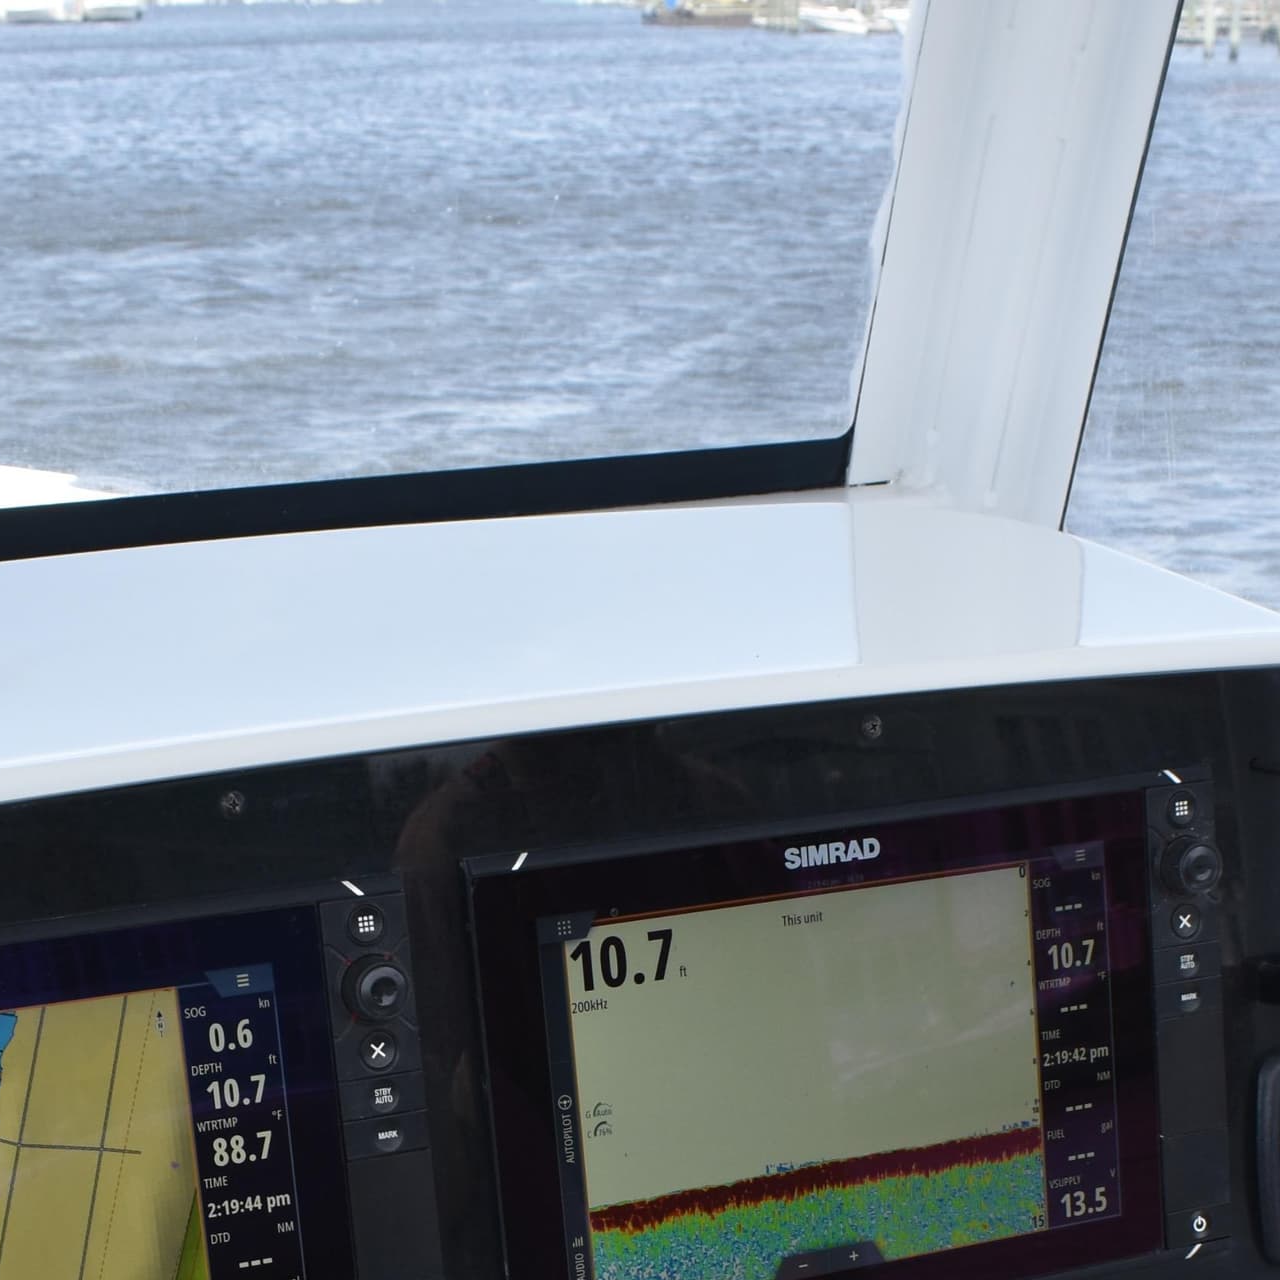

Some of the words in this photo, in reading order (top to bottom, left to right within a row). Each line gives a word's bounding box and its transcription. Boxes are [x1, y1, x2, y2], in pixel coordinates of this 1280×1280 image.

[784, 837, 880, 870] SIMRAD
[1033, 878, 1051, 889] SOG
[782, 914, 802, 927] This
[803, 911, 823, 925] unit
[1036, 928, 1061, 941] DEPTH
[570, 929, 672, 992] 10.7
[680, 965, 687, 977] ft
[1047, 939, 1095, 971] 10.7
[1038, 976, 1072, 991] WTRTMP
[184, 1006, 207, 1019] SOG
[258, 997, 270, 1009] kn
[572, 998, 608, 1014] 200kHz
[208, 1018, 253, 1053] 0.6
[1042, 1029, 1061, 1041] TIME
[191, 1062, 222, 1076] DEPTH
[269, 1053, 278, 1065] ft
[1043, 1047, 1087, 1067] 2:19:42
[1090, 1045, 1109, 1063] pm
[1044, 1079, 1061, 1091] DTD
[1096, 1071, 1111, 1081] NM
[206, 1074, 266, 1110] 10.7
[374, 1087, 391, 1097] STBY
[375, 1094, 393, 1105] AUTO
[197, 1117, 238, 1133] WTRTMP
[378, 1130, 398, 1140] MARK
[1047, 1129, 1065, 1140] FUEL
[212, 1130, 272, 1167] 88.7
[561, 1113, 575, 1164] AUTOPILOT
[204, 1176, 229, 1190] TIME
[1049, 1175, 1081, 1189] VSUPPLY
[207, 1195, 262, 1219] 2:19:44
[267, 1193, 291, 1213] pm
[1060, 1186, 1107, 1218] 13.5
[210, 1231, 230, 1245] DTD
[277, 1221, 294, 1233] NM
